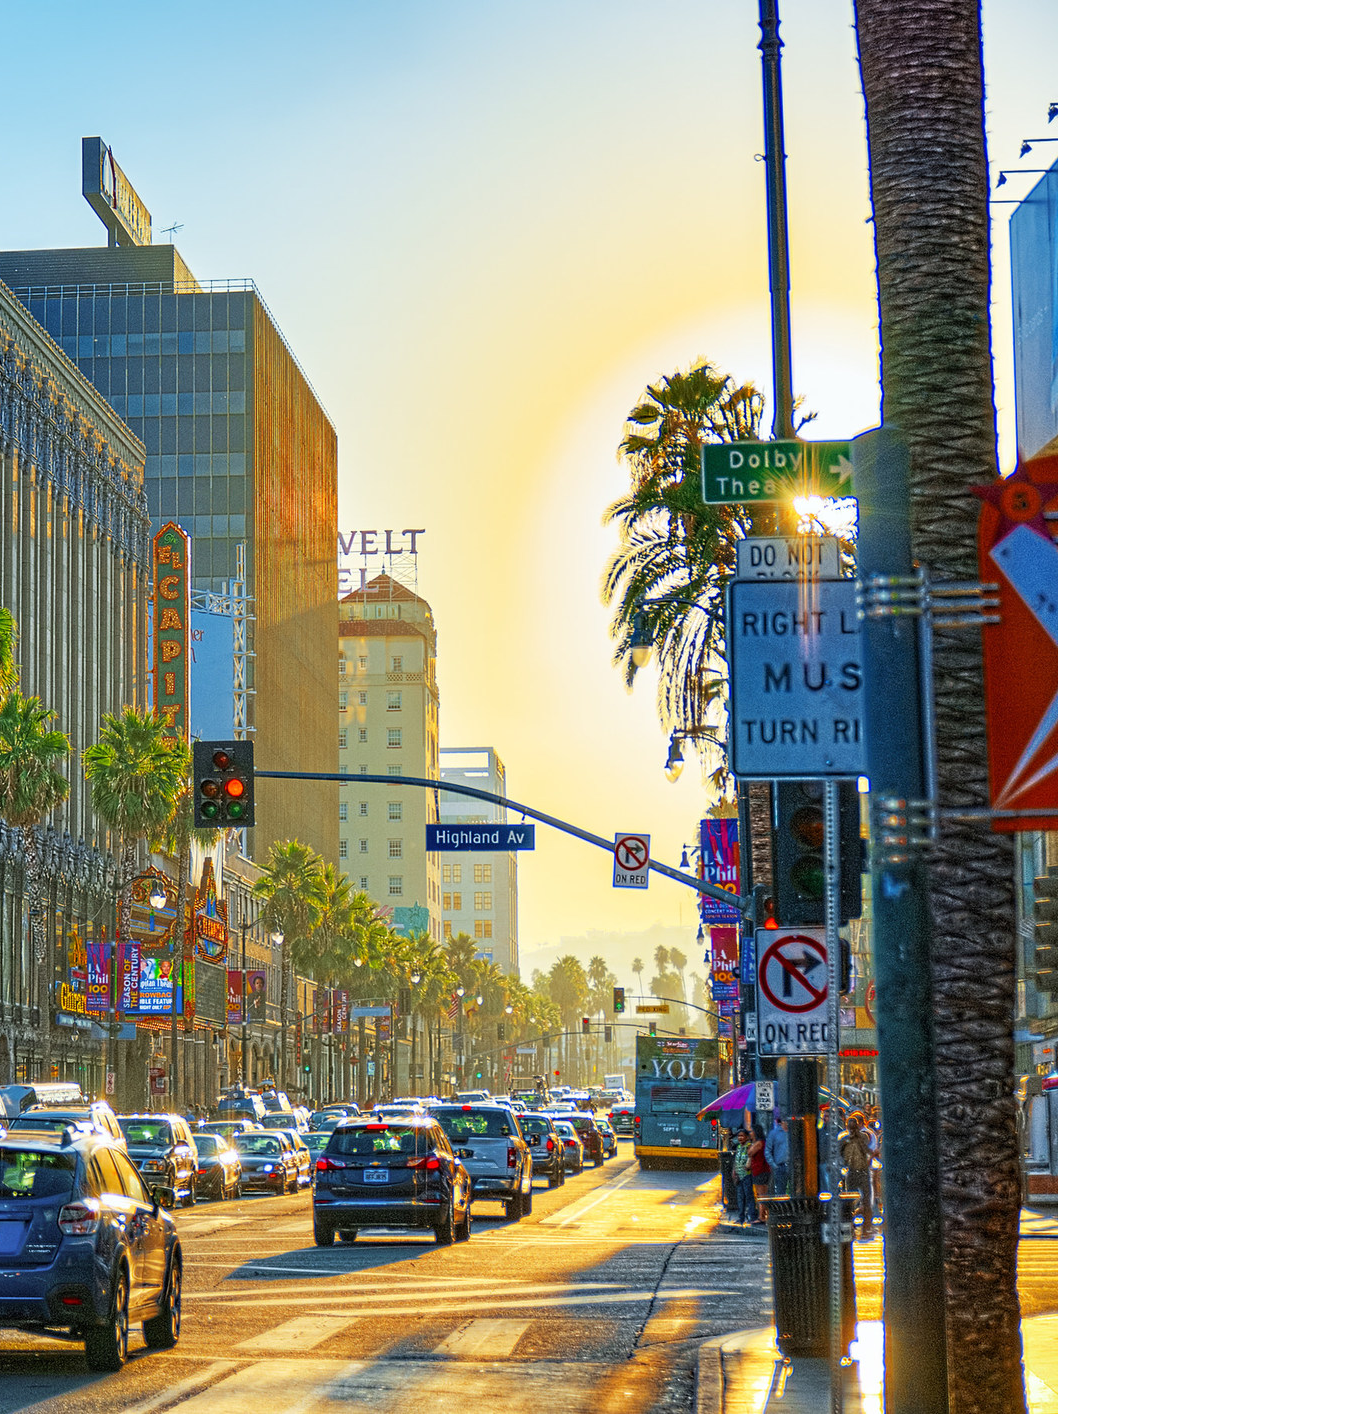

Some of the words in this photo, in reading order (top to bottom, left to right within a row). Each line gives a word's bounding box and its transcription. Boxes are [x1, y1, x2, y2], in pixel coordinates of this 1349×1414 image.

[729, 449, 803, 472] Dolby
[158, 545, 185, 570] EL
[750, 544, 776, 567] DO
[788, 542, 825, 567] NOT
[741, 611, 825, 637] RIGHT
[741, 719, 819, 744] TURN
[435, 830, 499, 848] Highland
[506, 830, 525, 845] Av
[703, 850, 724, 865] LA
[615, 874, 627, 883] ON
[629, 874, 646, 884] RED
[704, 864, 737, 881] Phil
[712, 949, 728, 960] LA
[87, 963, 101, 974] LA
[123, 958, 131, 971] OF
[130, 947, 139, 989] CENTURY
[712, 960, 736, 971] Phil
[88, 973, 109, 984] Phil
[88, 984, 108, 993] 100
[123, 973, 131, 1008] SEASON
[130, 990, 139, 1008] THE
[765, 1023, 789, 1043] ON
[796, 1022, 829, 1043] RED
[650, 1059, 707, 1080] YOU
